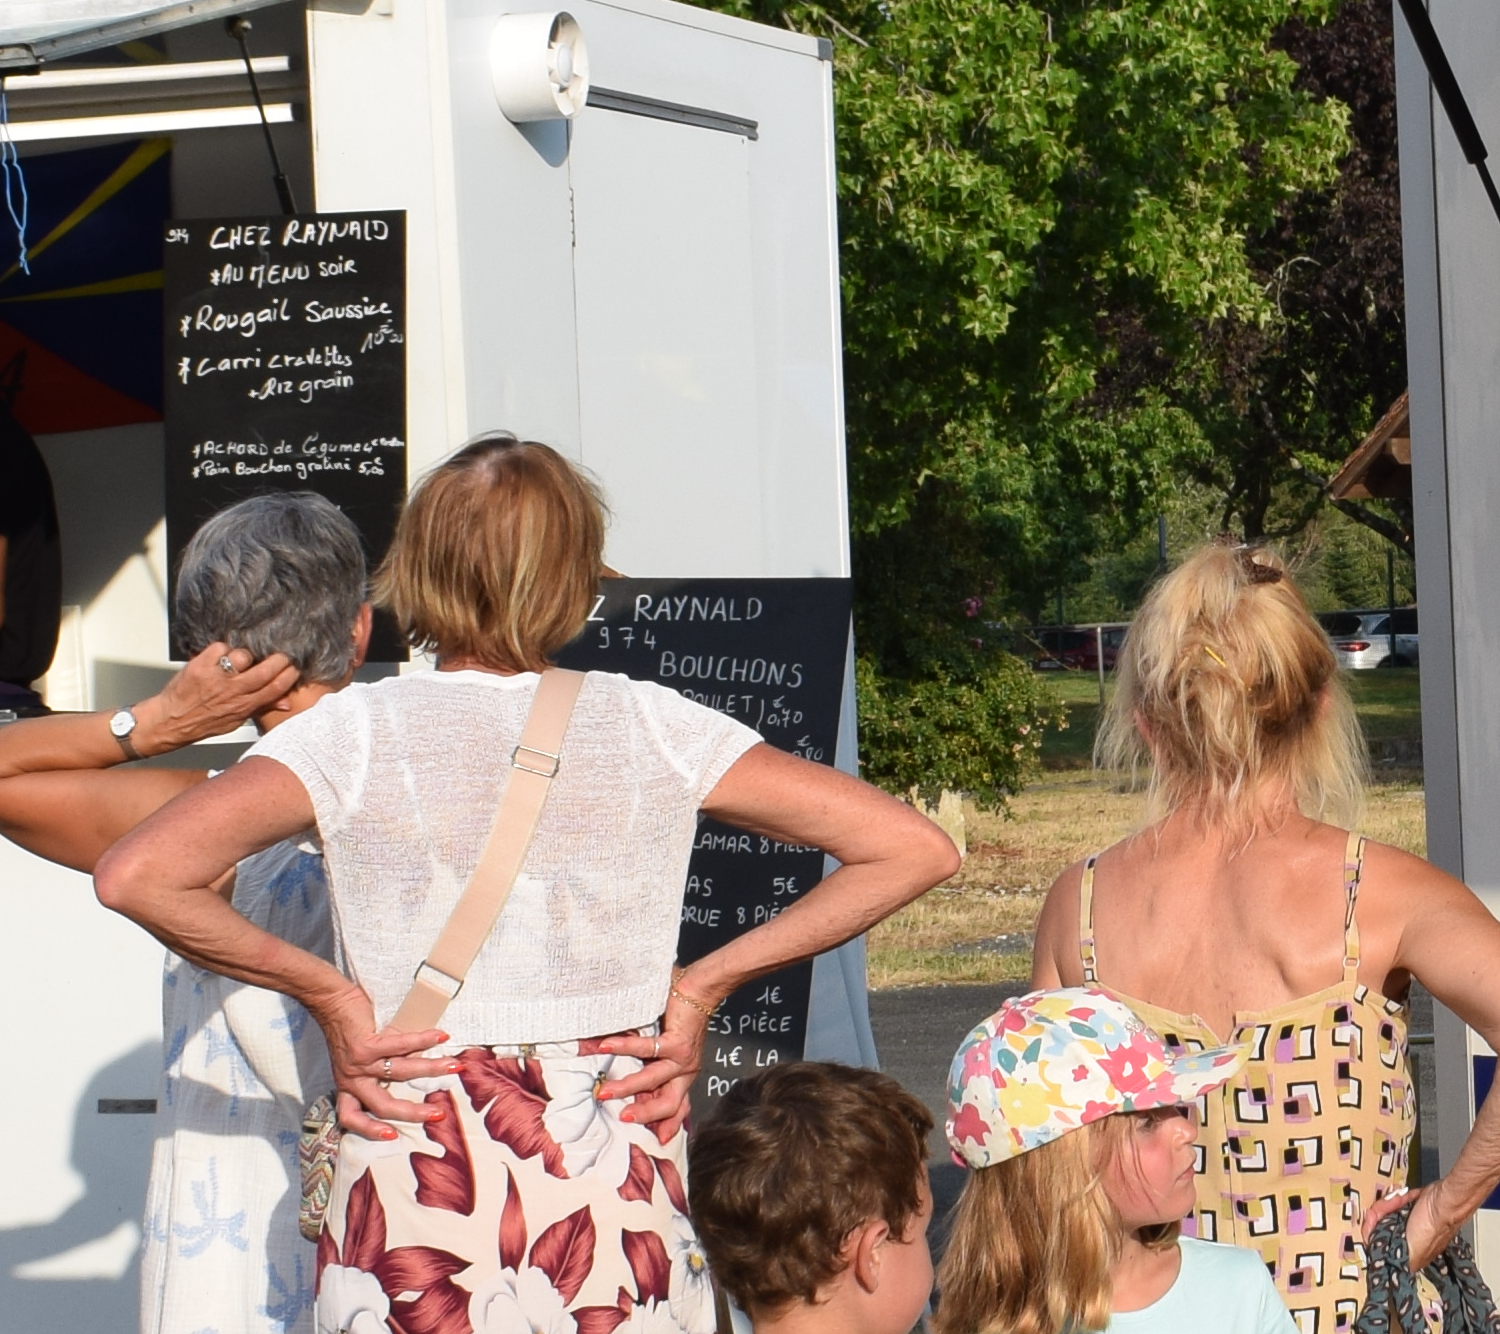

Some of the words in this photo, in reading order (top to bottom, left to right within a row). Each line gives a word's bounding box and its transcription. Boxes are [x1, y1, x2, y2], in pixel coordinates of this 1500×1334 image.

[209, 225, 271, 250] CHEZ
[249, 264, 310, 289] MENU
[195, 298, 291, 338] Rougail
[299, 370, 355, 404] grain
[273, 439, 294, 455] de
[634, 594, 762, 622] RAYNALD
[659, 650, 803, 688] BOUCHONS
[759, 835, 770, 854] 8
[773, 876, 799, 896] 5€
[736, 906, 746, 924] 8
[756, 986, 783, 1005] 1€
[715, 1045, 743, 1068] 4€
[755, 1049, 779, 1067] LA
